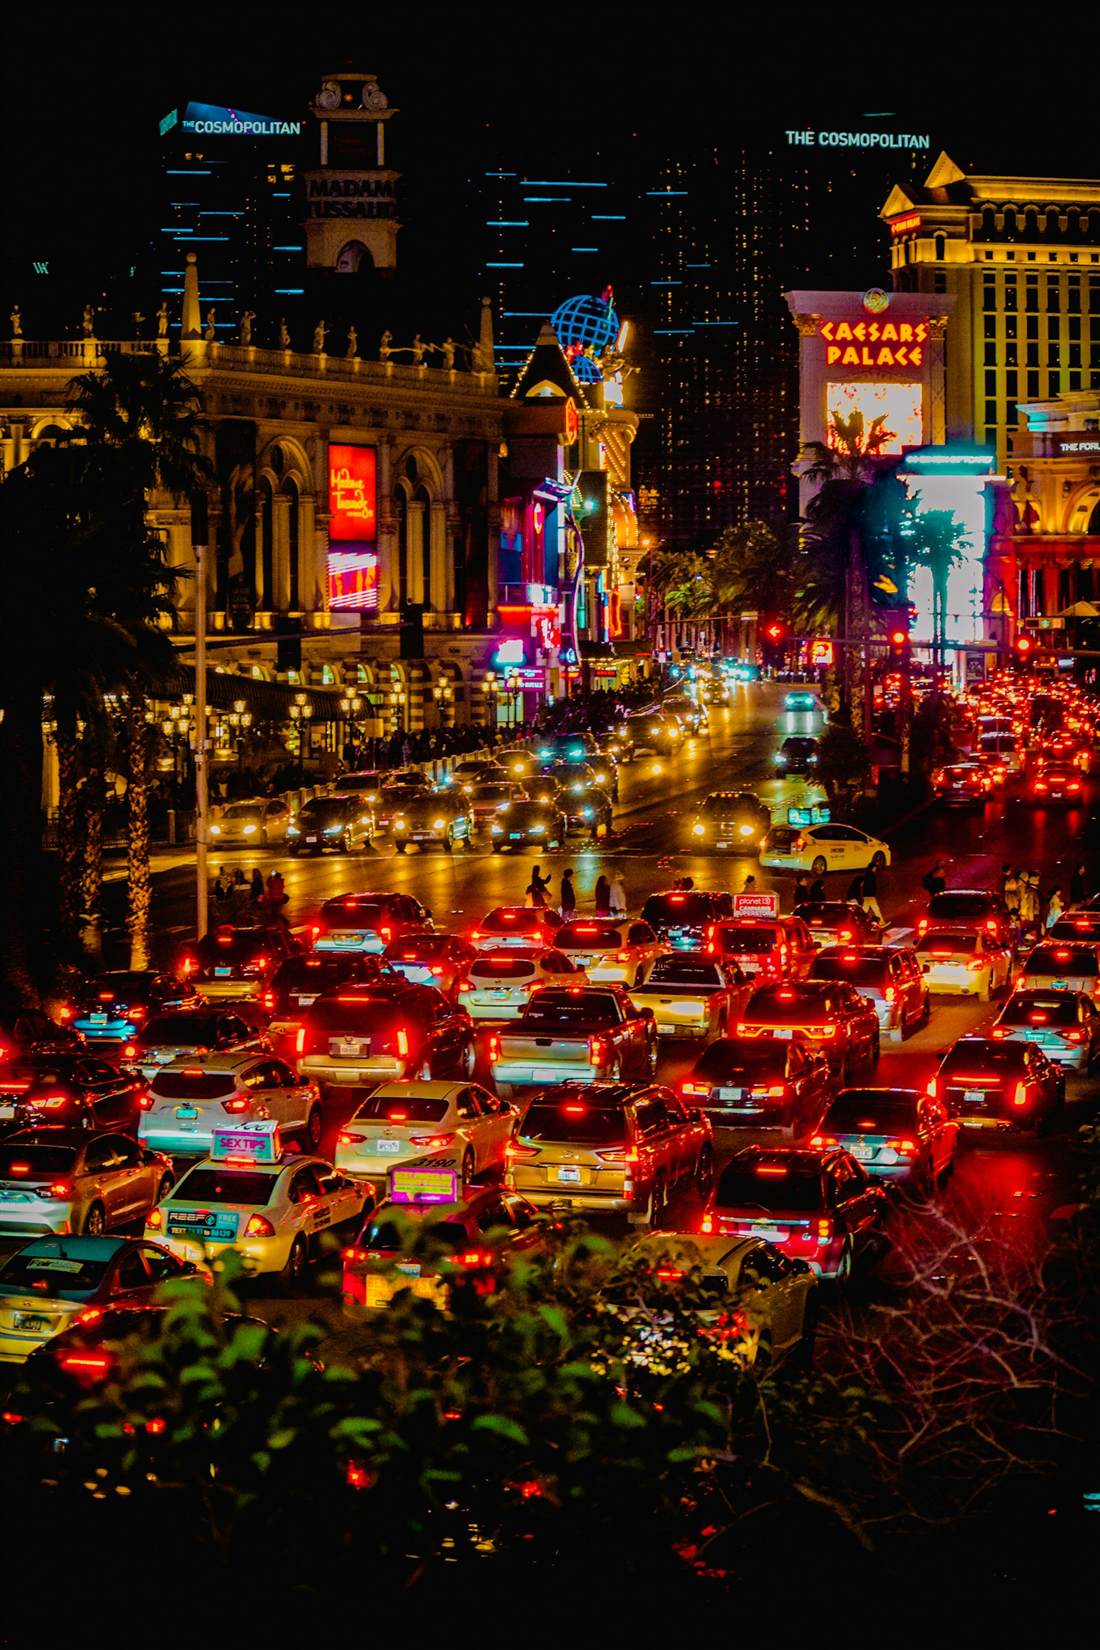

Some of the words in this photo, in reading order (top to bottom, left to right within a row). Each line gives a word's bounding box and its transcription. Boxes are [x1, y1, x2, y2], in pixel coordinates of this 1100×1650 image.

[183, 120, 195, 128] THE
[195, 121, 300, 135] COSMOPOLITAN
[785, 130, 815, 146] THE
[819, 132, 930, 149] COSMOPOLITAN
[820, 322, 928, 343] CAESARS
[826, 346, 922, 366] PALACE
[1060, 443, 1079, 451] THE
[220, 1137, 241, 1148] SEX
[242, 1139, 266, 1150] TIPS
[412, 1158, 457, 1168] 3190
[169, 1212, 206, 1220] REEF
